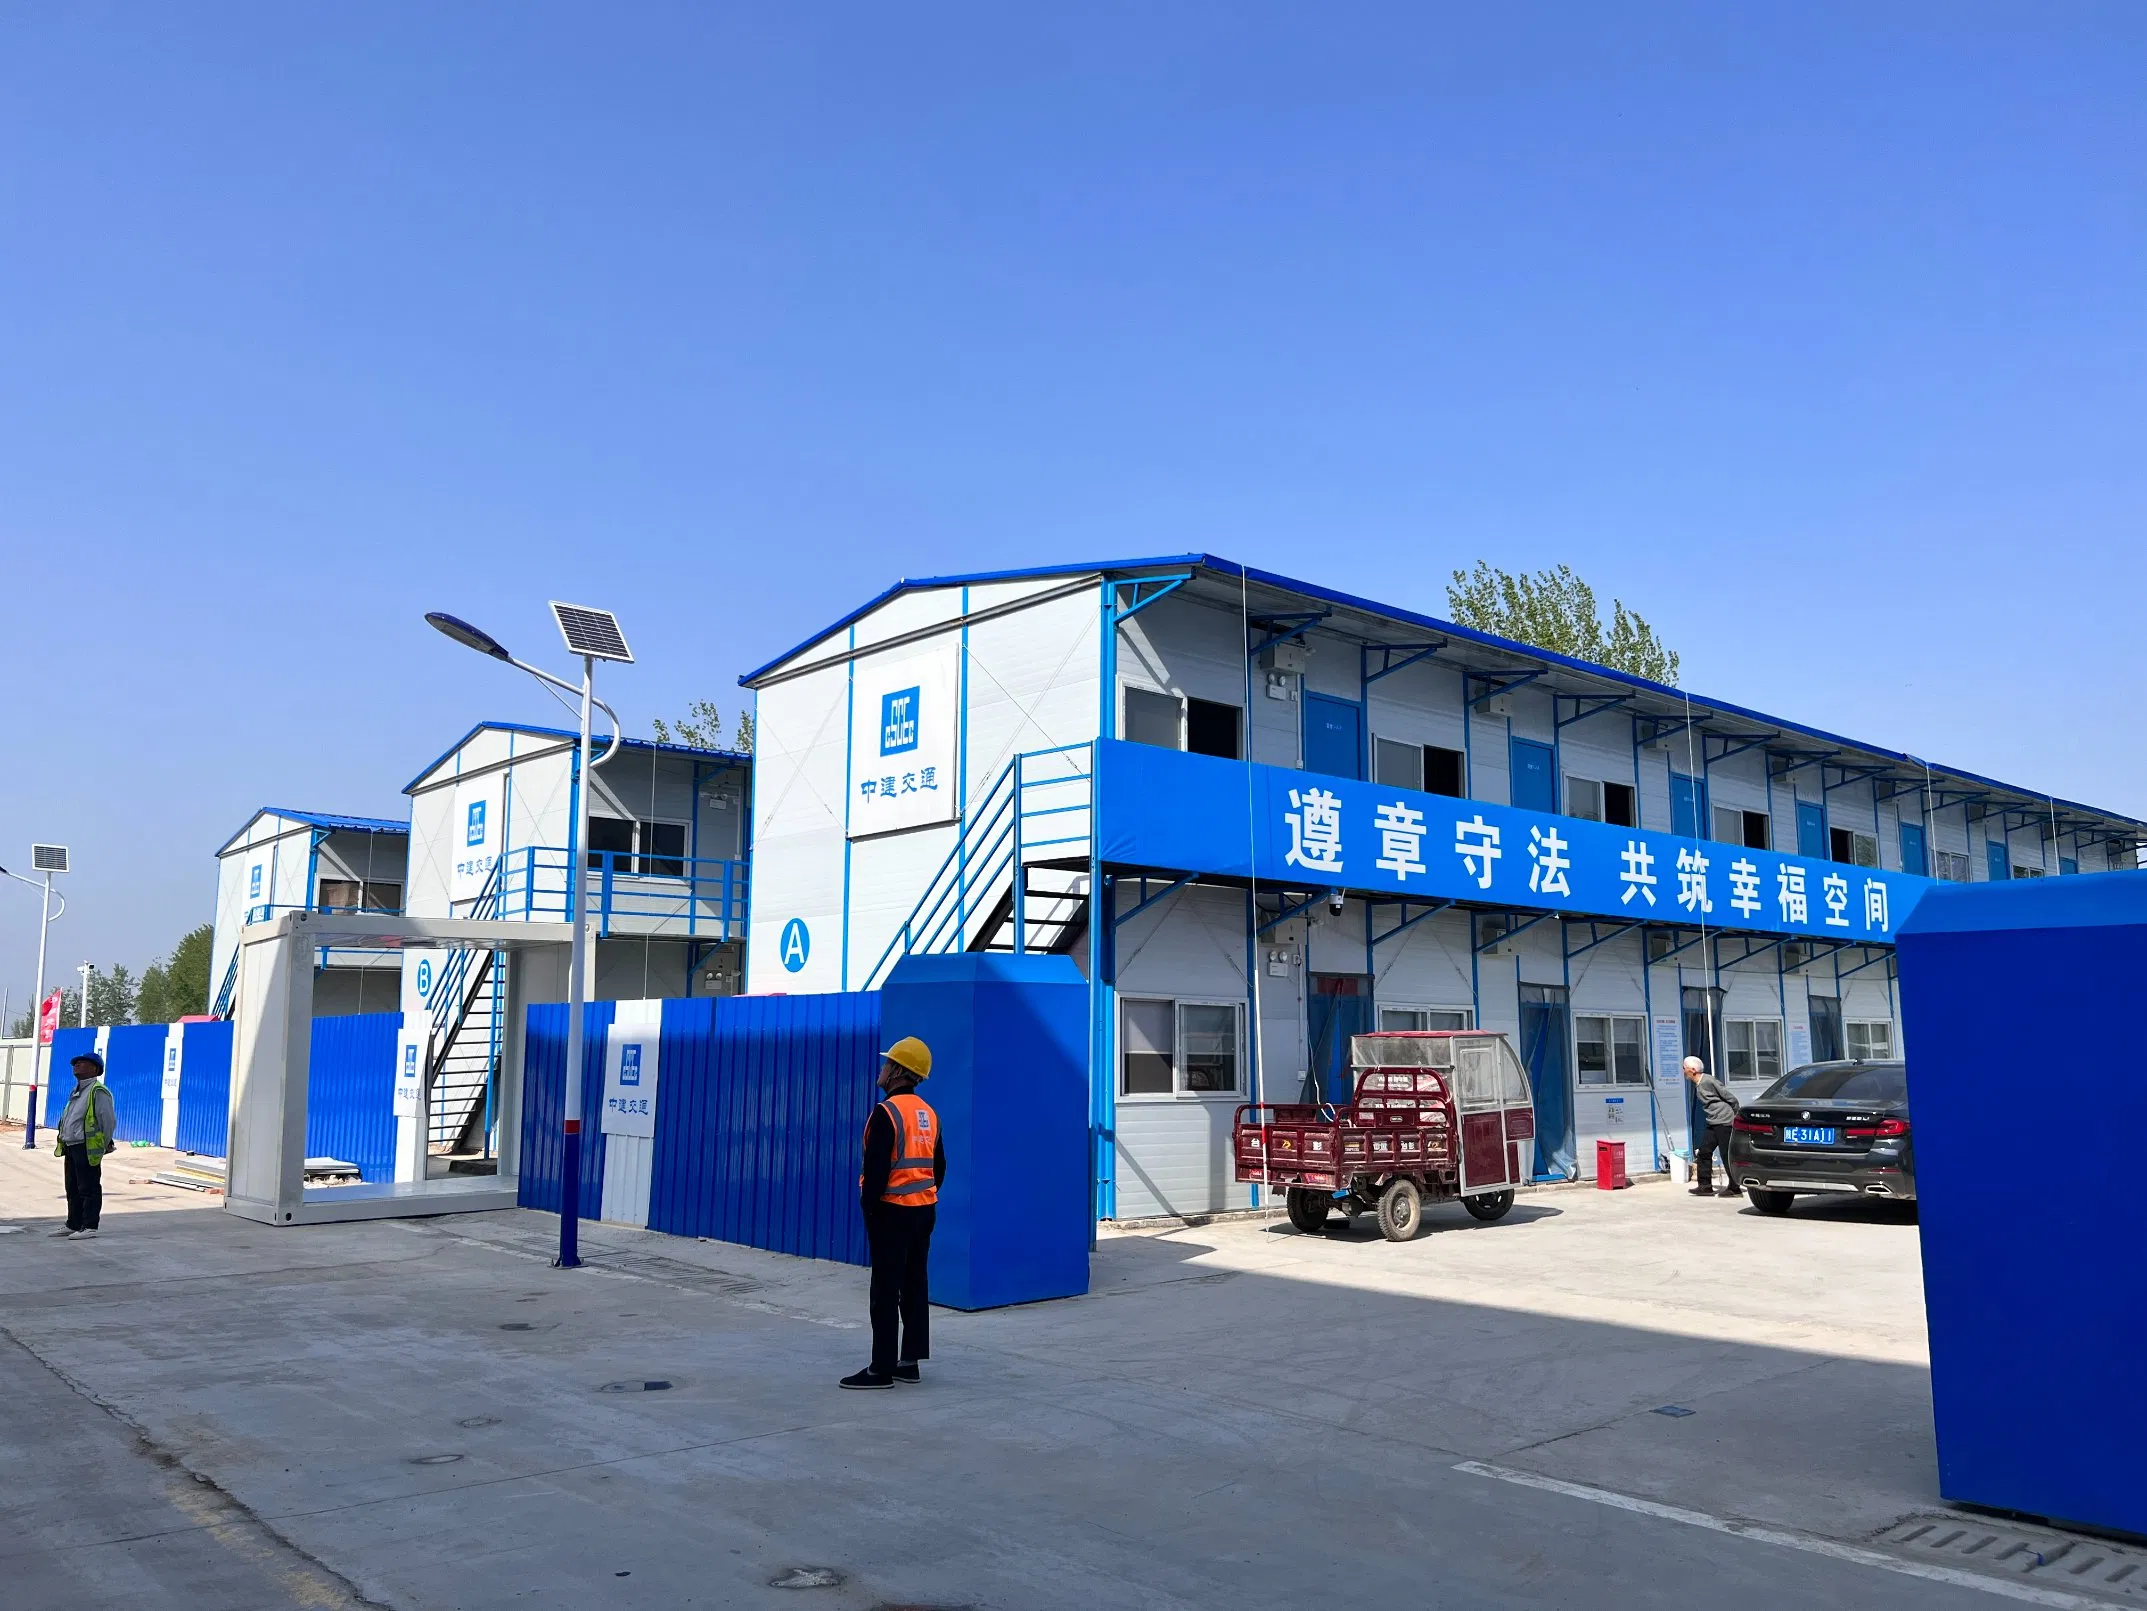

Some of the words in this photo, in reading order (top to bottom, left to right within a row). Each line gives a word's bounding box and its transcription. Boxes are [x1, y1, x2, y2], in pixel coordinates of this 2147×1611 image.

[860, 766, 939, 804] 中建交通
[1284, 787, 1571, 898] 遵章守法
[1619, 840, 1889, 933] 共筑幸福空间
[784, 922, 805, 965] A
[419, 963, 429, 993] B
[608, 1097, 649, 1116] 中建交通
